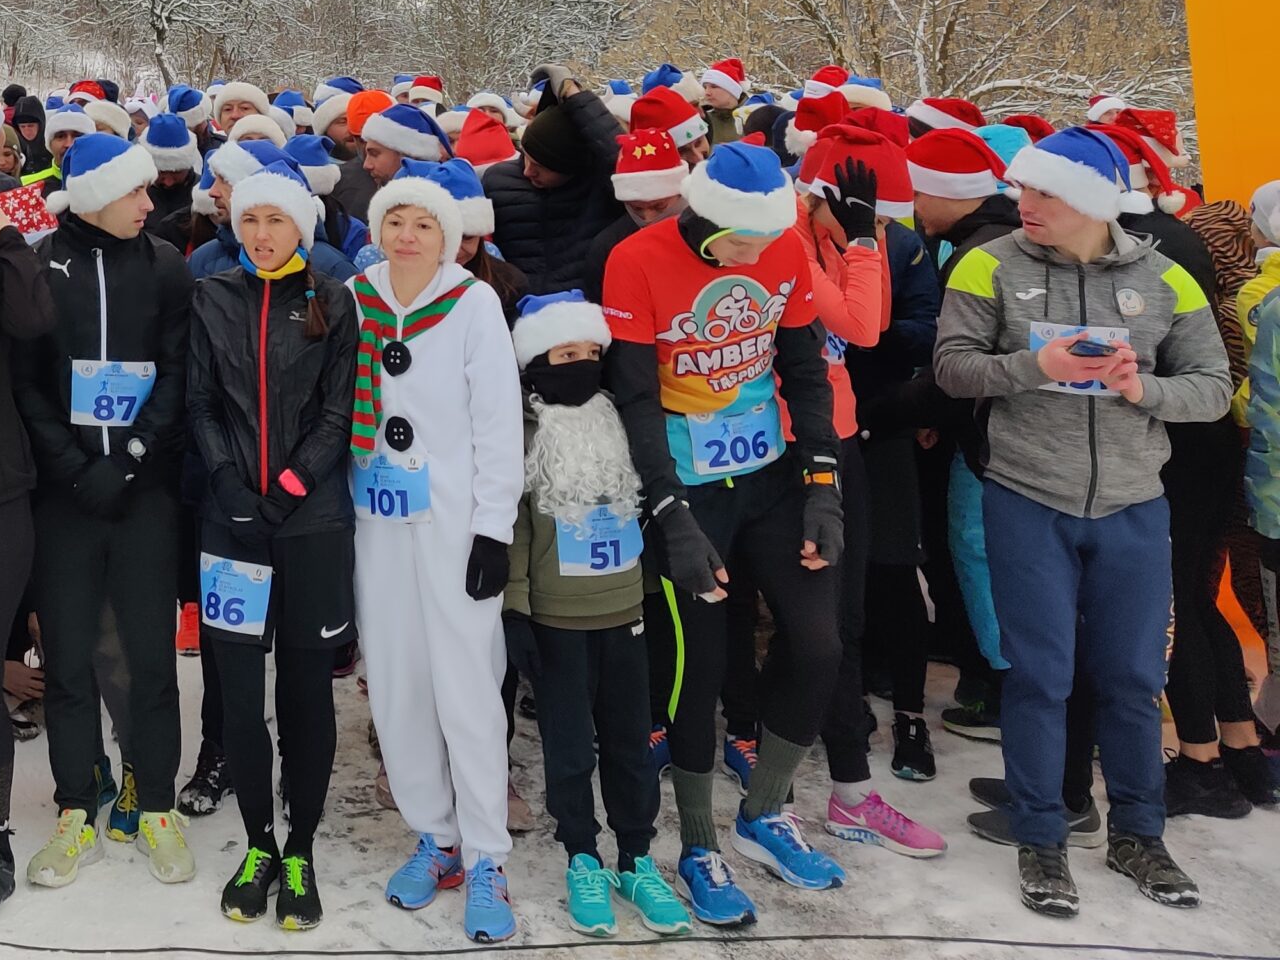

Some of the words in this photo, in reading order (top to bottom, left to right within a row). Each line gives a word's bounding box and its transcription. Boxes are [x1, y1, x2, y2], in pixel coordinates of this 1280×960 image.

[676, 333, 772, 375] AMBER
[93, 395, 137, 421] 87
[704, 431, 769, 468] 206
[366, 488, 409, 518] 101
[590, 540, 621, 570] 51
[205, 591, 246, 626] 86
